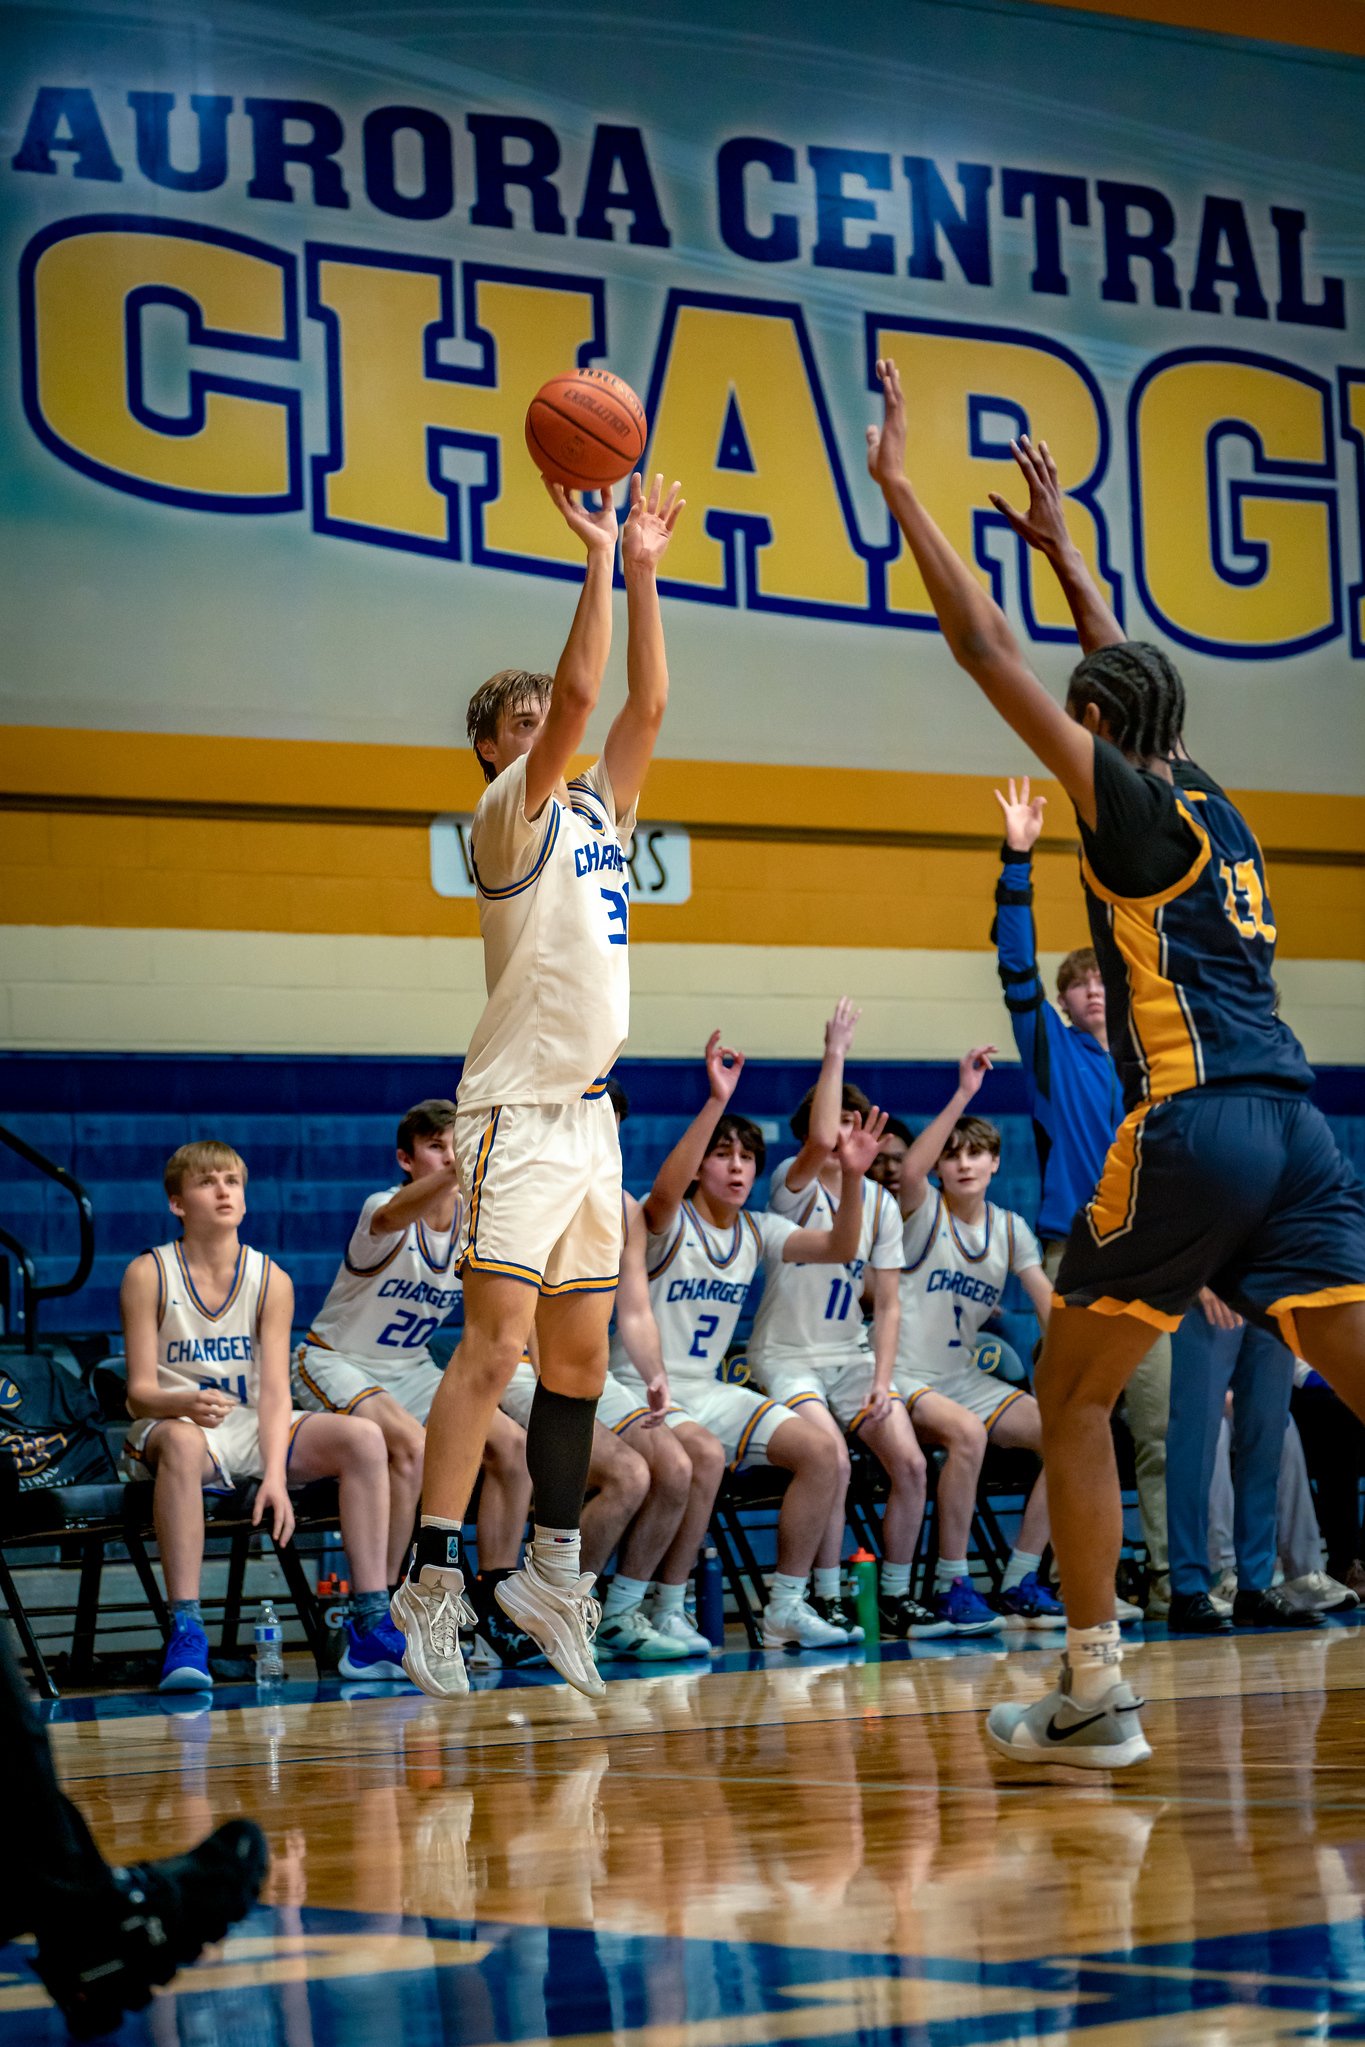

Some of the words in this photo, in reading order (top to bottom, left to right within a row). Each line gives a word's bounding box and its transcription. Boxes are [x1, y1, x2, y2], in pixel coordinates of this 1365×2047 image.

[11, 86, 671, 248] AURORA
[716, 136, 1346, 330] CENTRAL
[825, 1278, 853, 1321] 11
[376, 1309, 440, 1349] 20
[688, 1314, 720, 1359] 2
